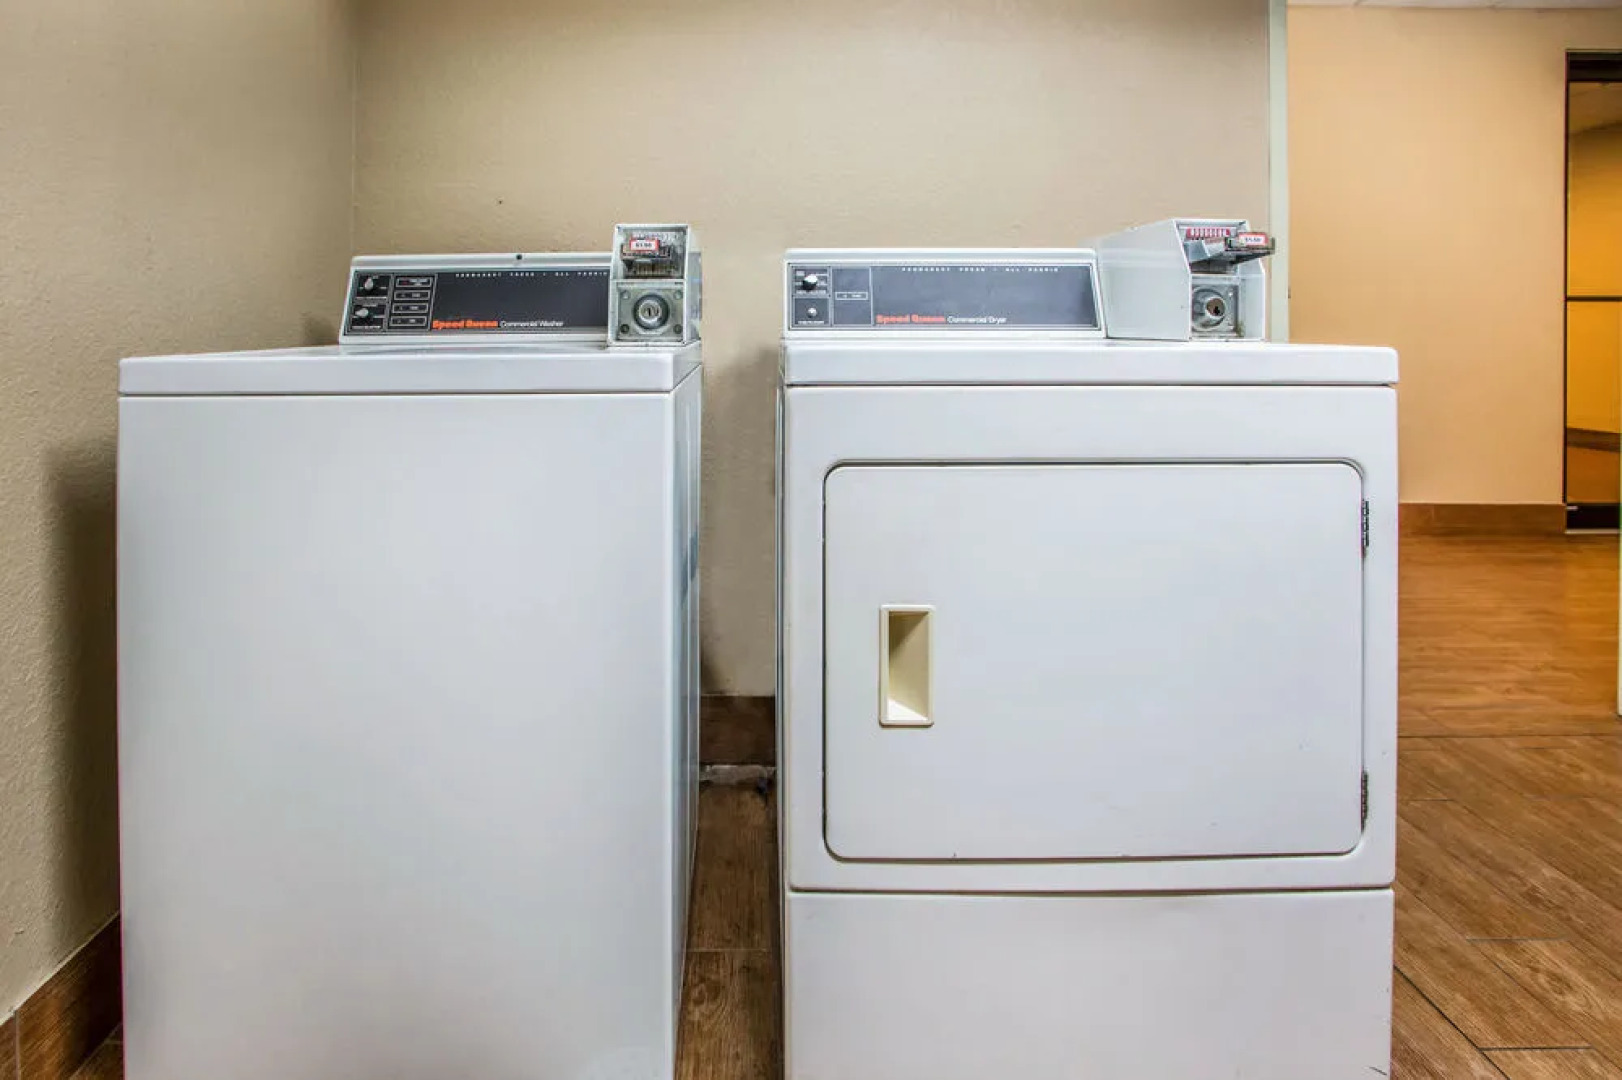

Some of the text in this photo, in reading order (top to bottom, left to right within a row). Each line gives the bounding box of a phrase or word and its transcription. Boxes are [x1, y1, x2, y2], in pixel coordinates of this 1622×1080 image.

[432, 319, 564, 329] Speed Queen Commercial Washer
[876, 314, 1008, 325] Speed Queen Commercial Dryer
